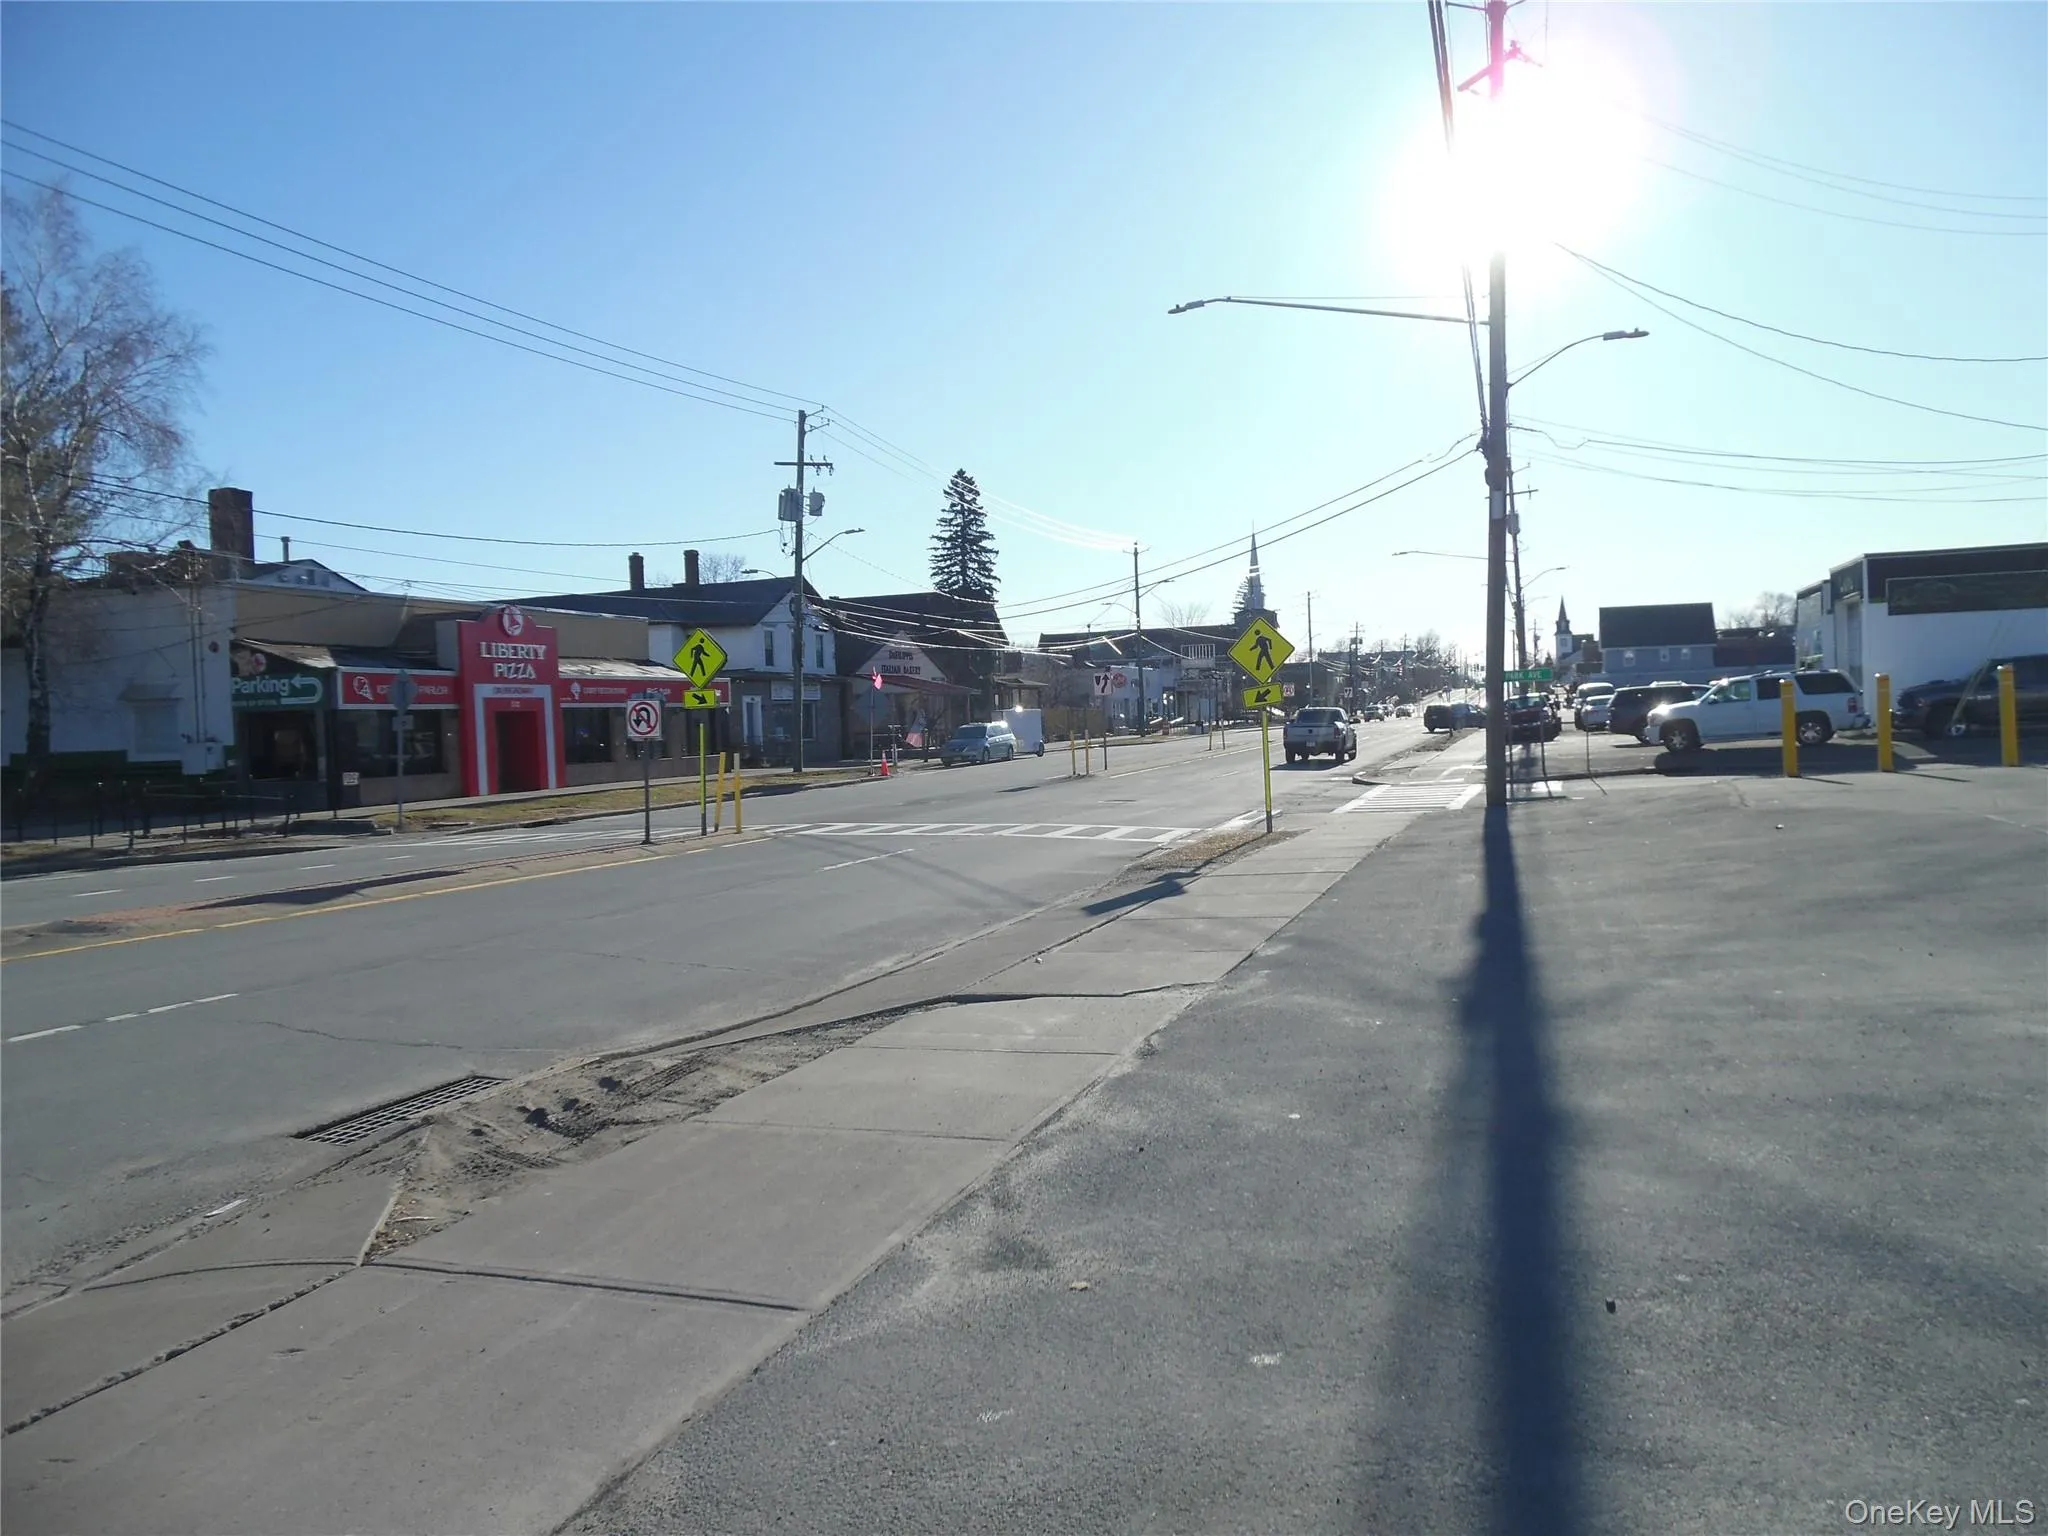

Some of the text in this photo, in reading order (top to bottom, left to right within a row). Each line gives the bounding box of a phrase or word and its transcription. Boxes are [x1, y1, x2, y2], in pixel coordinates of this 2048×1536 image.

[480, 641, 547, 660] LIBERTY
[493, 662, 536, 679] PIZZA
[1528, 670, 1543, 679] AVE
[231, 675, 289, 697] Parking
